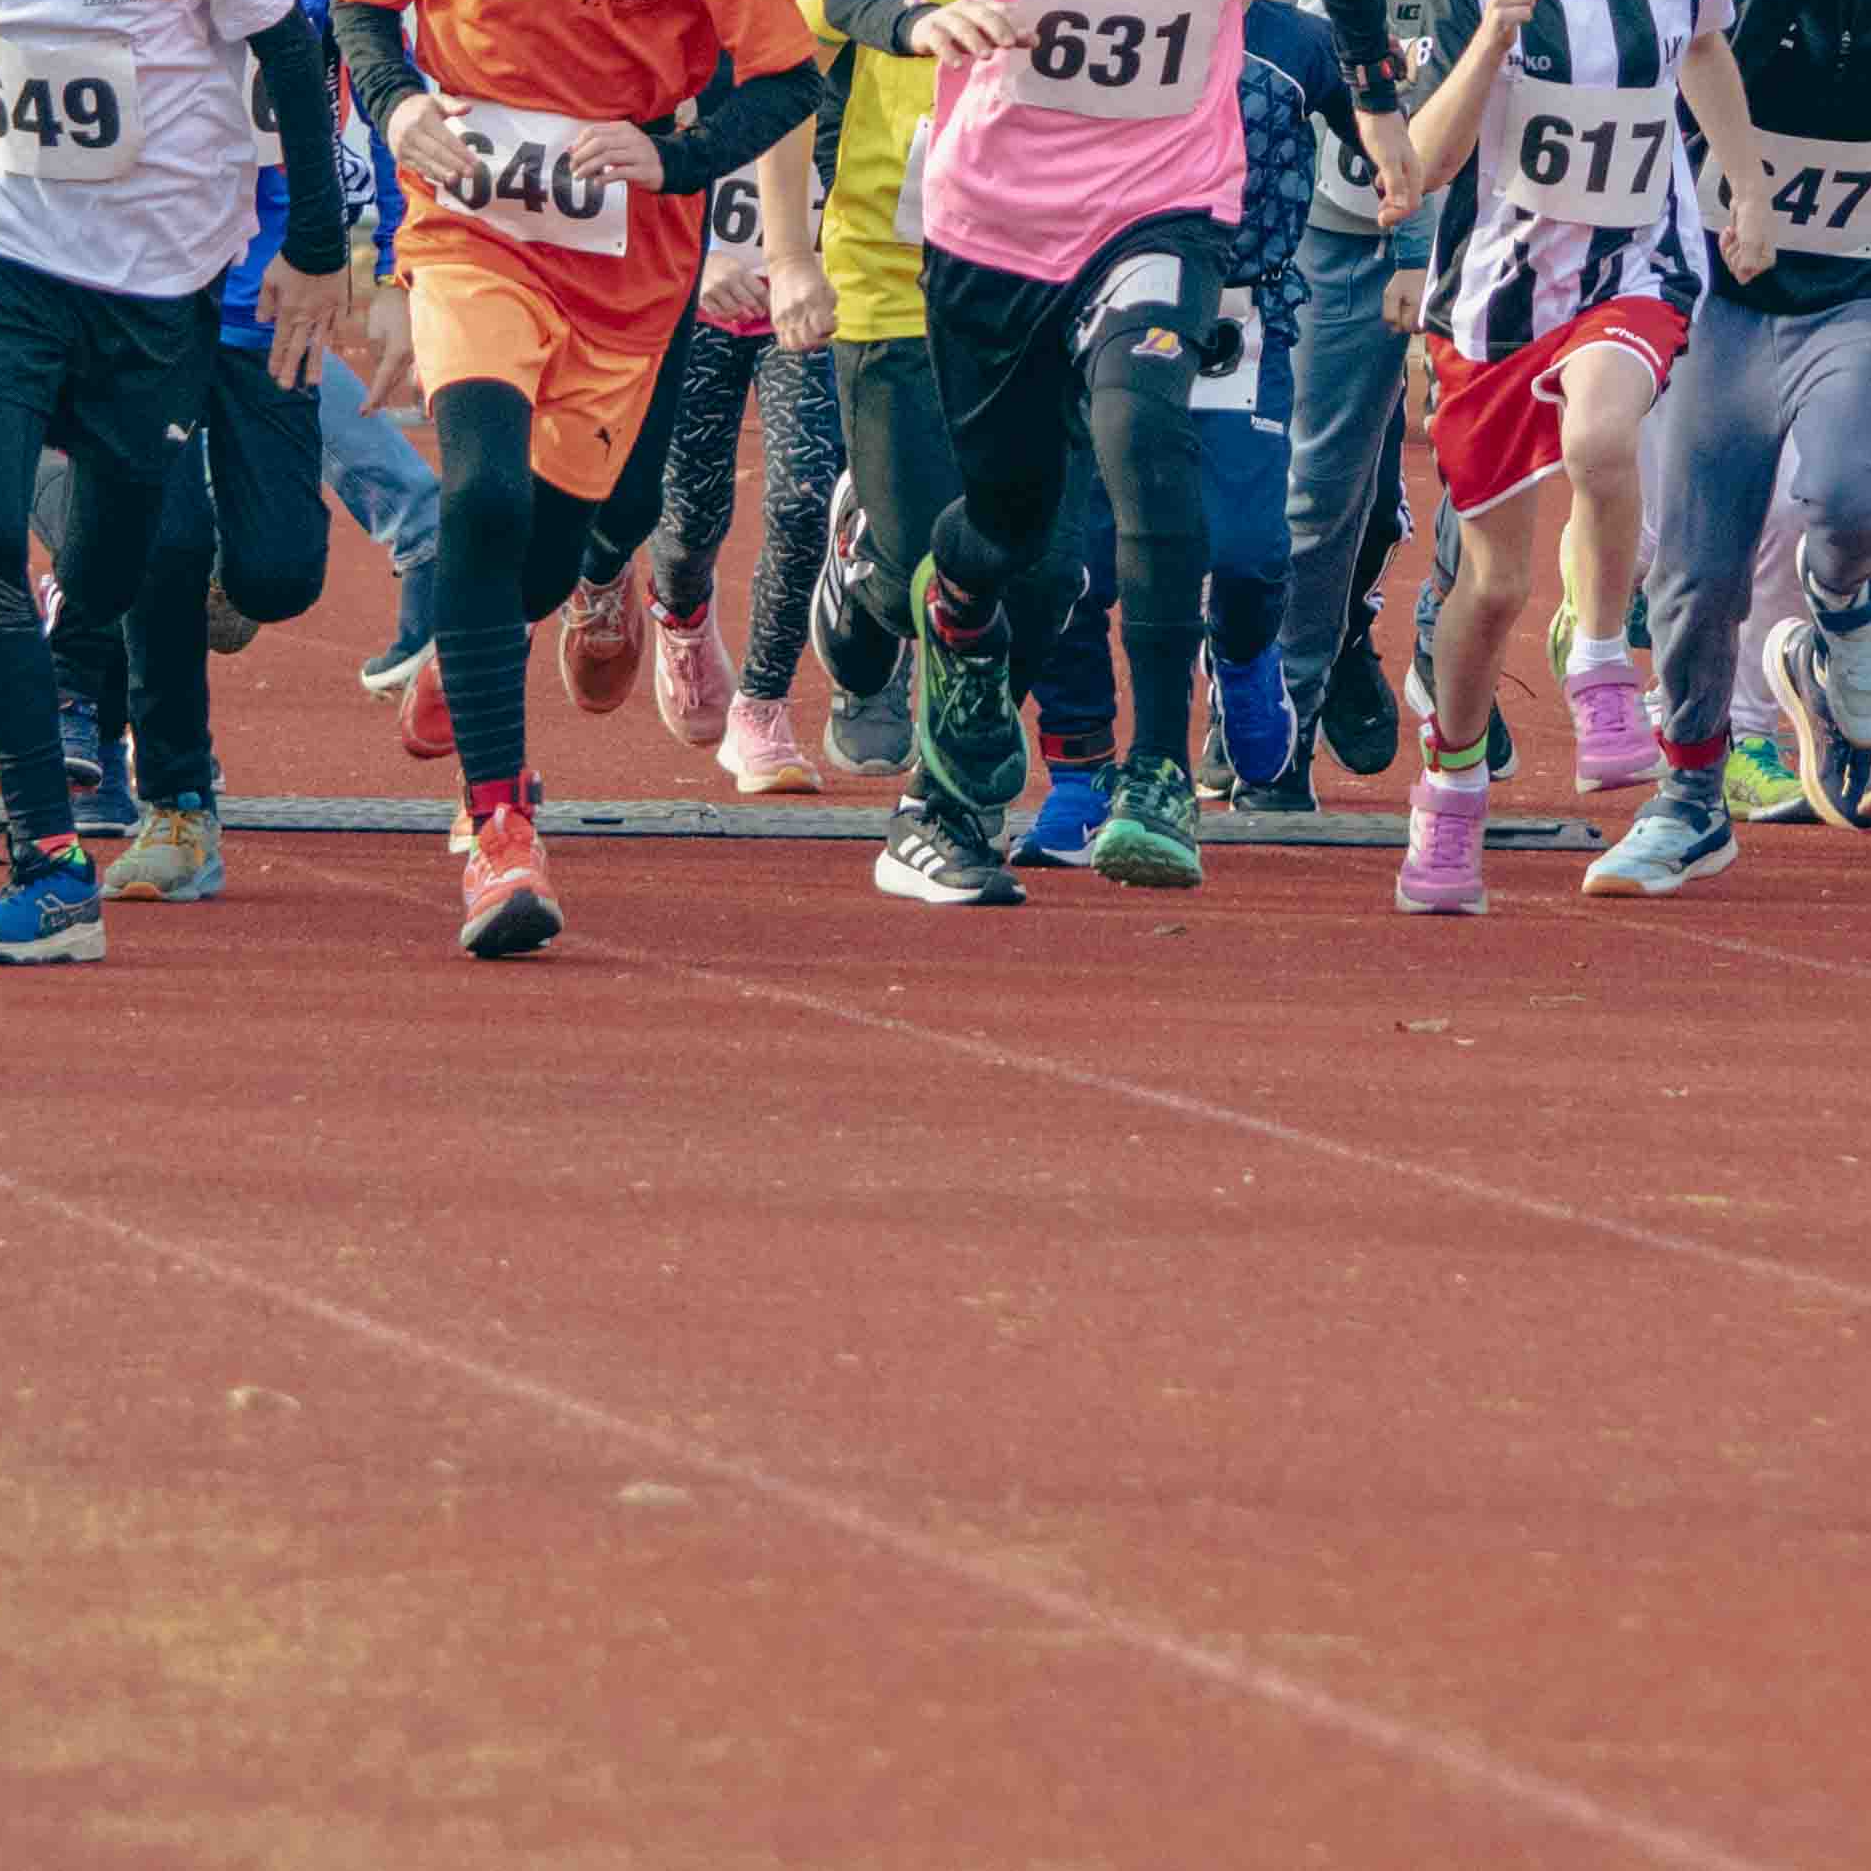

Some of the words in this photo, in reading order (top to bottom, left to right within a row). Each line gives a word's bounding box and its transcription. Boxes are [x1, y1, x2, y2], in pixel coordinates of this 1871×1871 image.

[1030, 9, 1192, 88] 631
[444, 130, 605, 220] 640
[1519, 113, 1667, 194] 617
